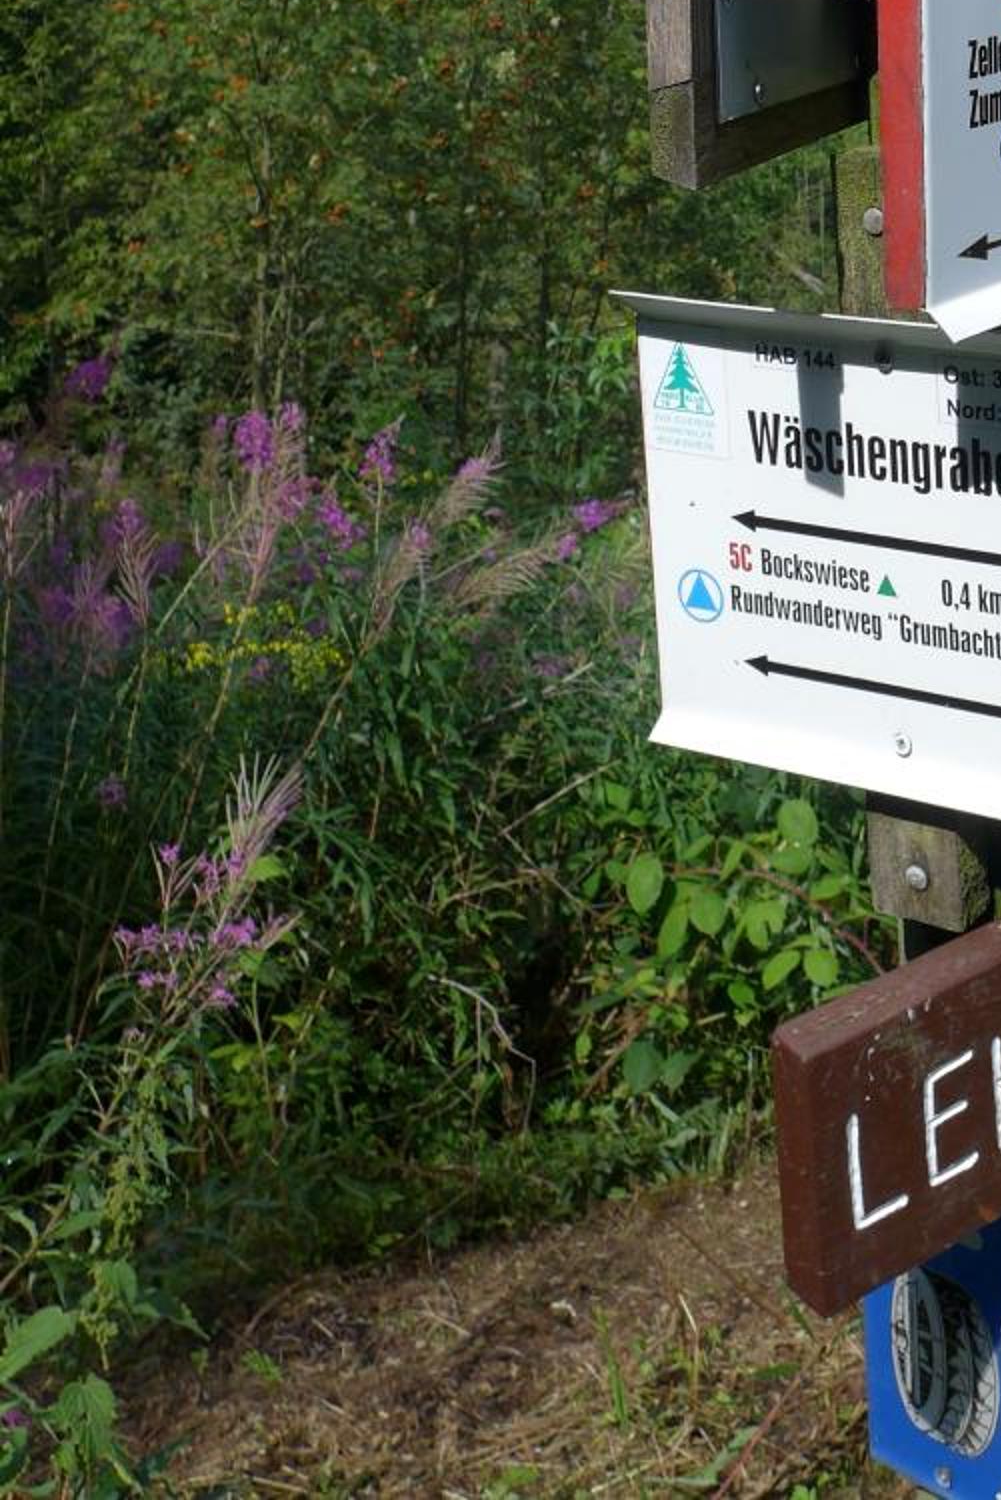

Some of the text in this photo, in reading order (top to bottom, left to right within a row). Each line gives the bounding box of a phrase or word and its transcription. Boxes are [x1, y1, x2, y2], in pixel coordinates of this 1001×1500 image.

[755, 344, 835, 369] HAB 144
[943, 366, 985, 388] Ost:
[947, 399, 1001, 422] Nord:
[729, 542, 752, 572] 5C
[761, 547, 871, 593] Bockswiese
[941, 579, 971, 612] 0,4
[730, 584, 882, 640] Rundwanderweg
